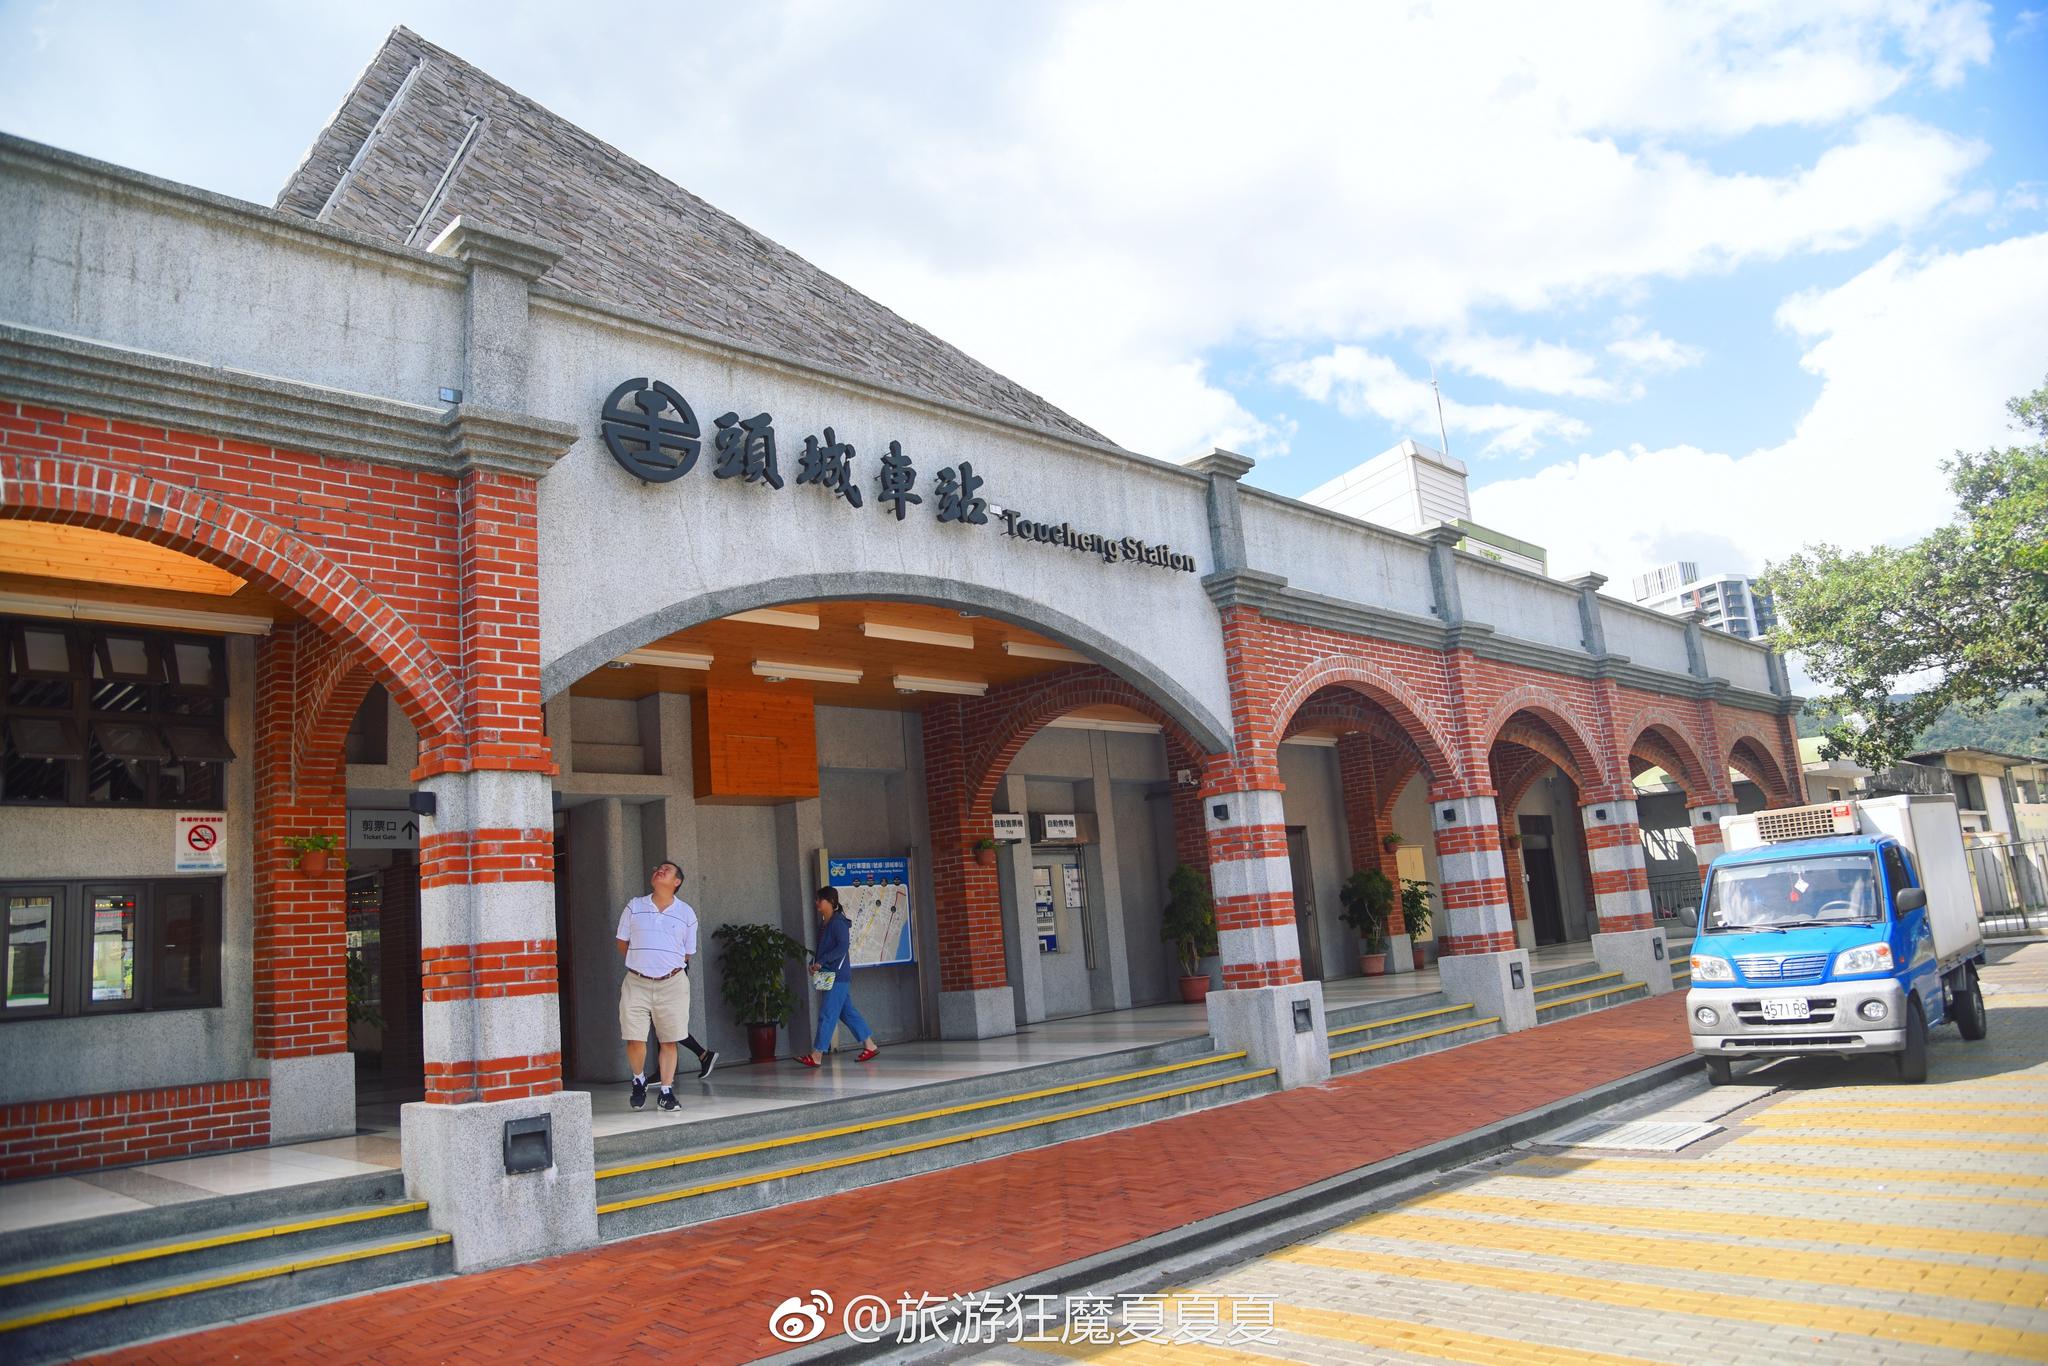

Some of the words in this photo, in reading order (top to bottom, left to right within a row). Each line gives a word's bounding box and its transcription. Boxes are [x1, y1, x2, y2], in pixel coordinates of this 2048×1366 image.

[713, 411, 989, 526] 頭城車站
[1002, 509, 1122, 564] Toucheng
[1121, 535, 1197, 573] Station
[362, 820, 397, 832] 剪票口
[994, 819, 1024, 828] 自動售票機
[1047, 819, 1075, 828] 自動售票機
[1763, 1003, 1790, 1017] 4571
[1793, 1002, 1808, 1015] R8
